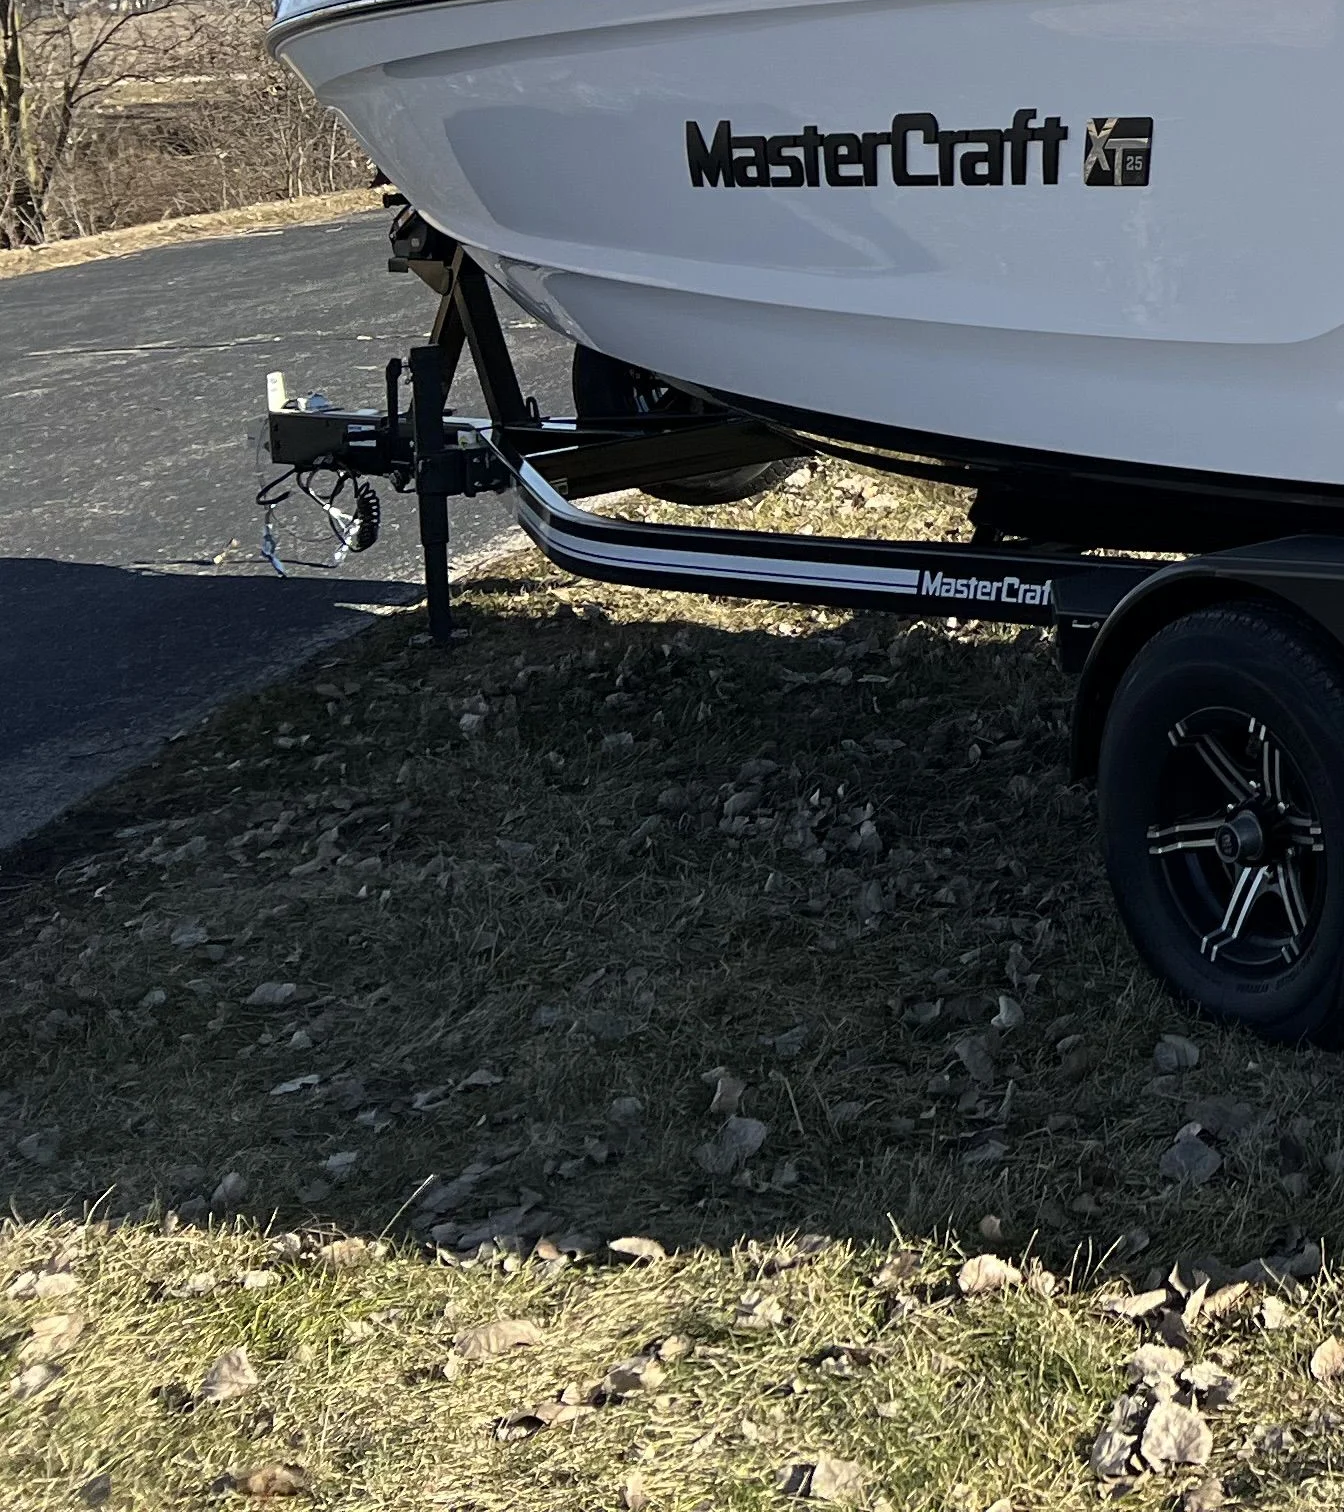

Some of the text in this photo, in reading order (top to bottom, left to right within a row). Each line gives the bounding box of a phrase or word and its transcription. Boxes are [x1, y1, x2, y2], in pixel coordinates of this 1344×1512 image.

[686, 108, 1068, 187] MasterCraft
[1126, 155, 1143, 171] 25
[922, 570, 1052, 606] MasterCraf
